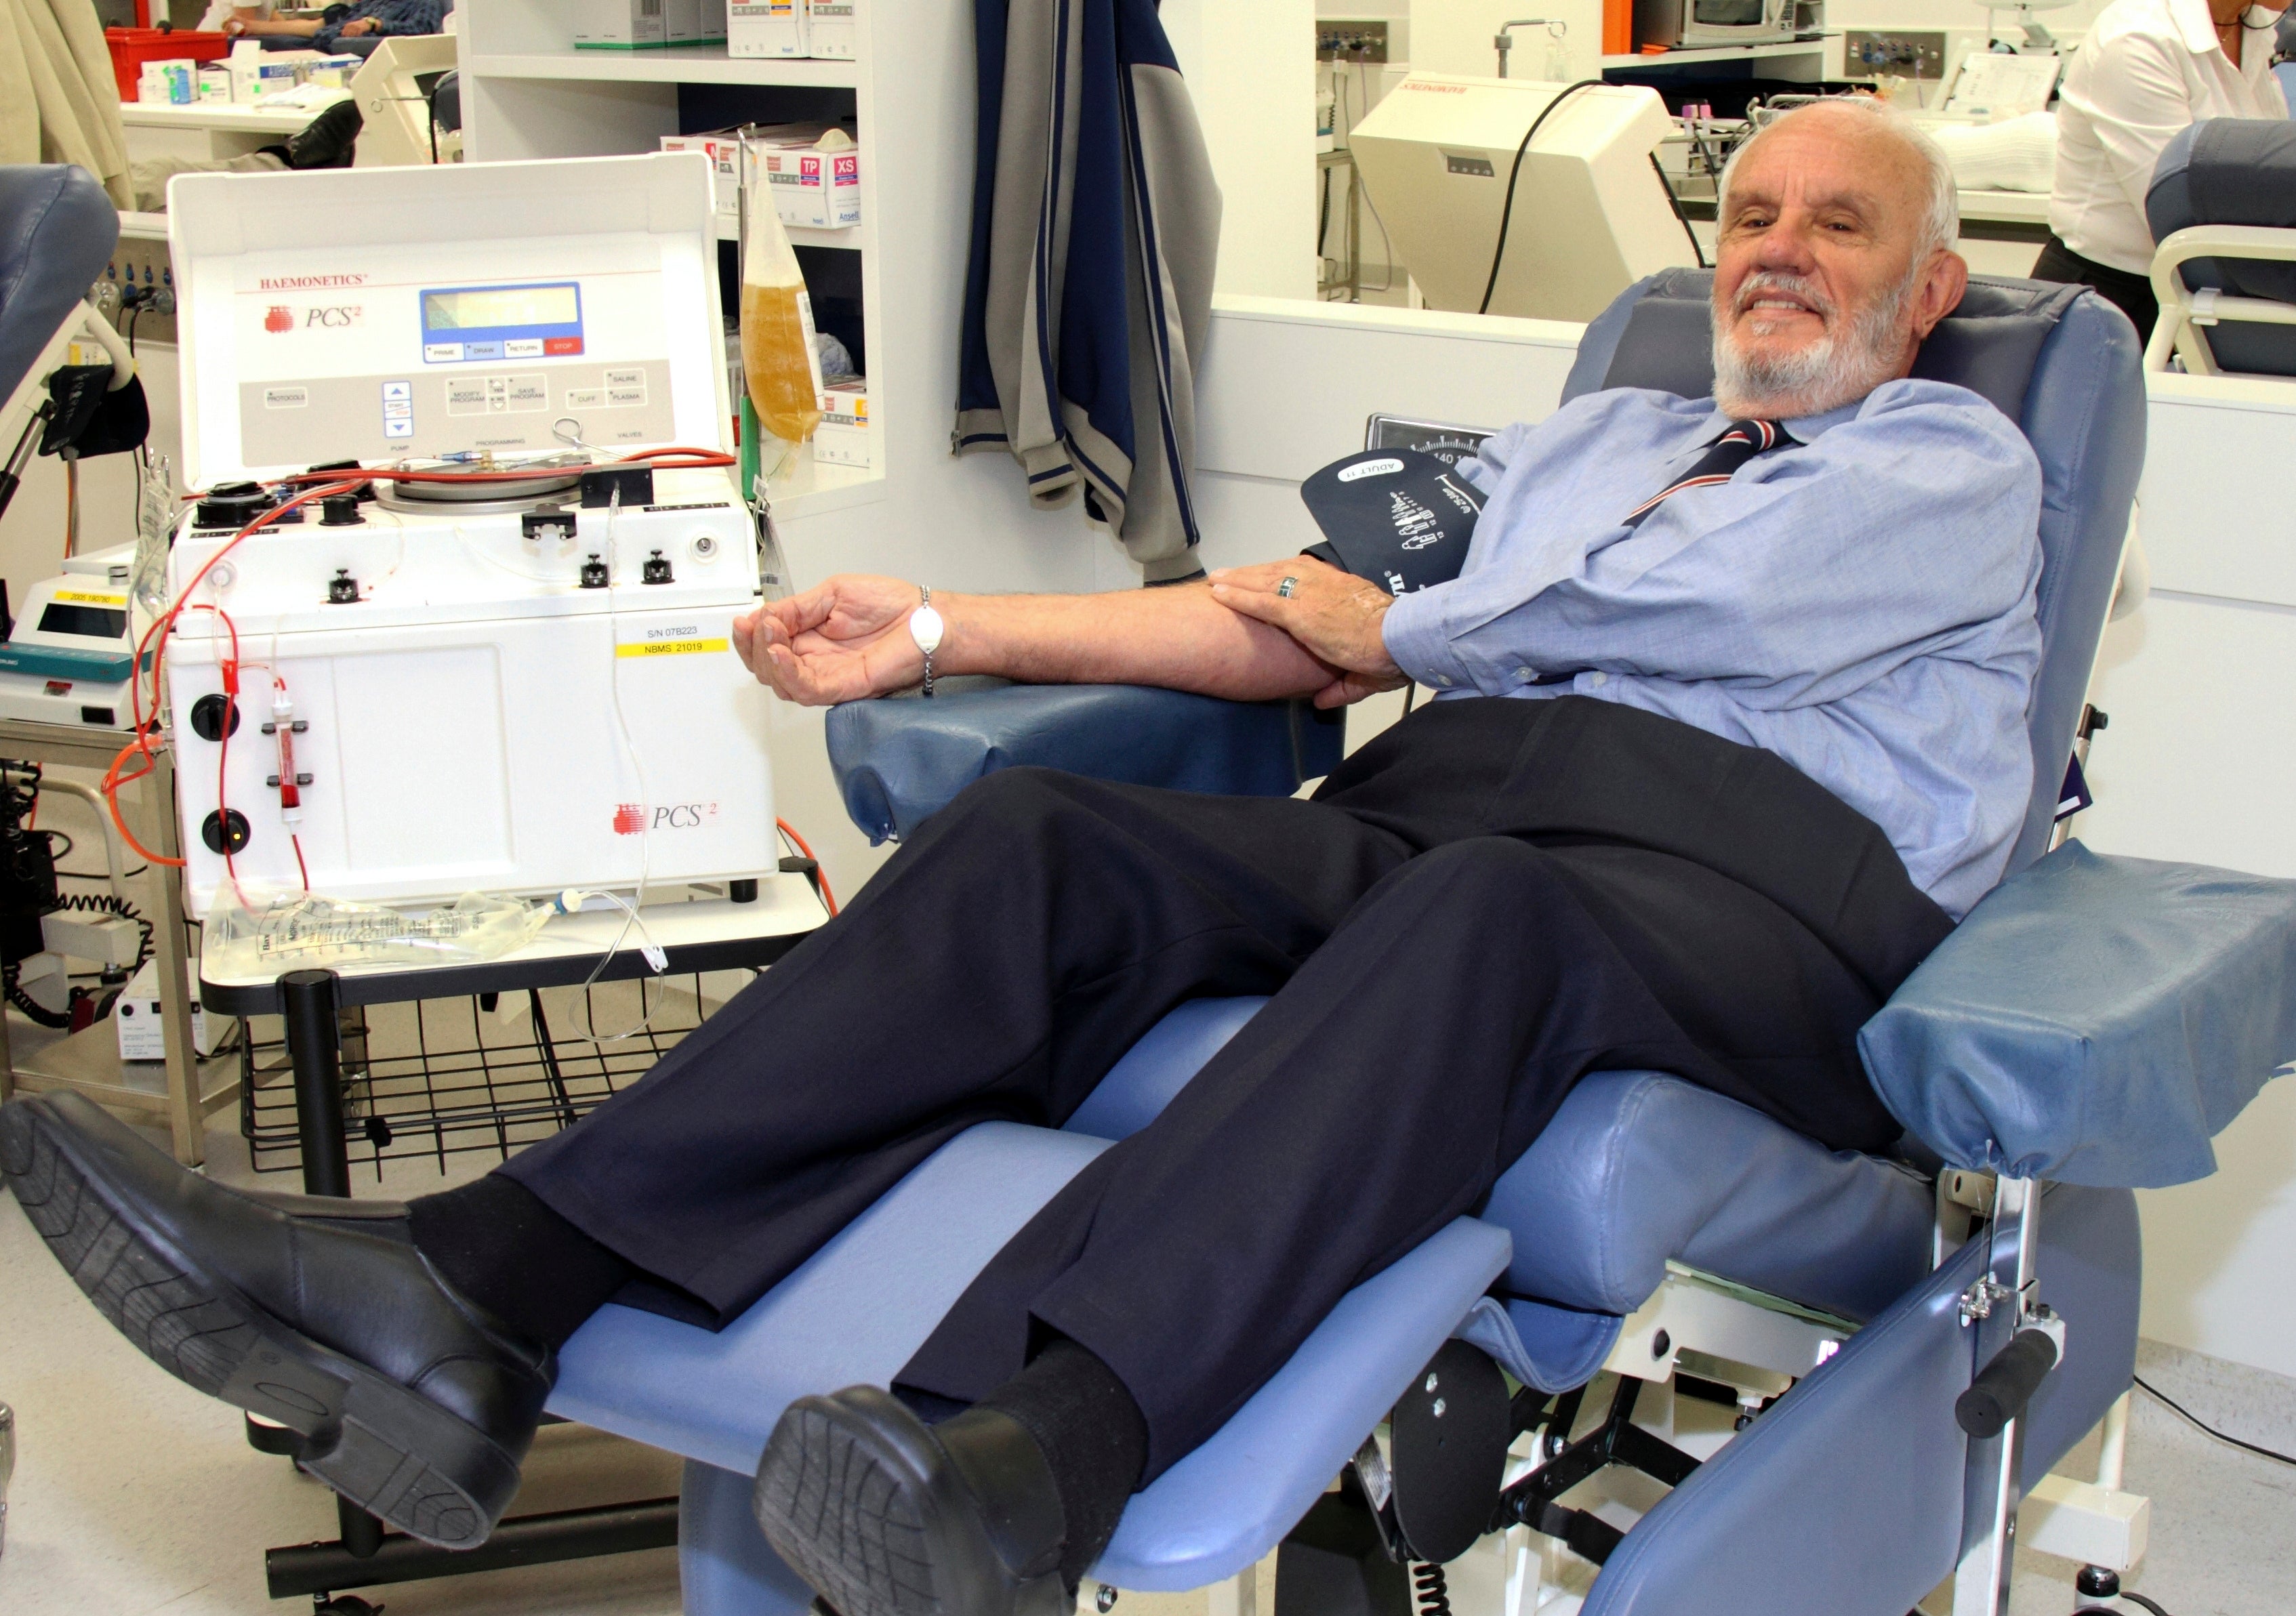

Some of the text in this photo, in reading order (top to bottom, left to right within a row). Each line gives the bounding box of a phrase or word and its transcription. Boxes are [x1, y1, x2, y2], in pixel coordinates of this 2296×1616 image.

[803, 160, 817, 173] TP
[838, 159, 854, 173] XS
[840, 211, 859, 222] Ansell
[476, 438, 525, 447] PROGRAMMING
[1360, 462, 1395, 475] ADULT
[647, 629, 663, 638] S/N
[644, 642, 703, 654] NBMS 21019
